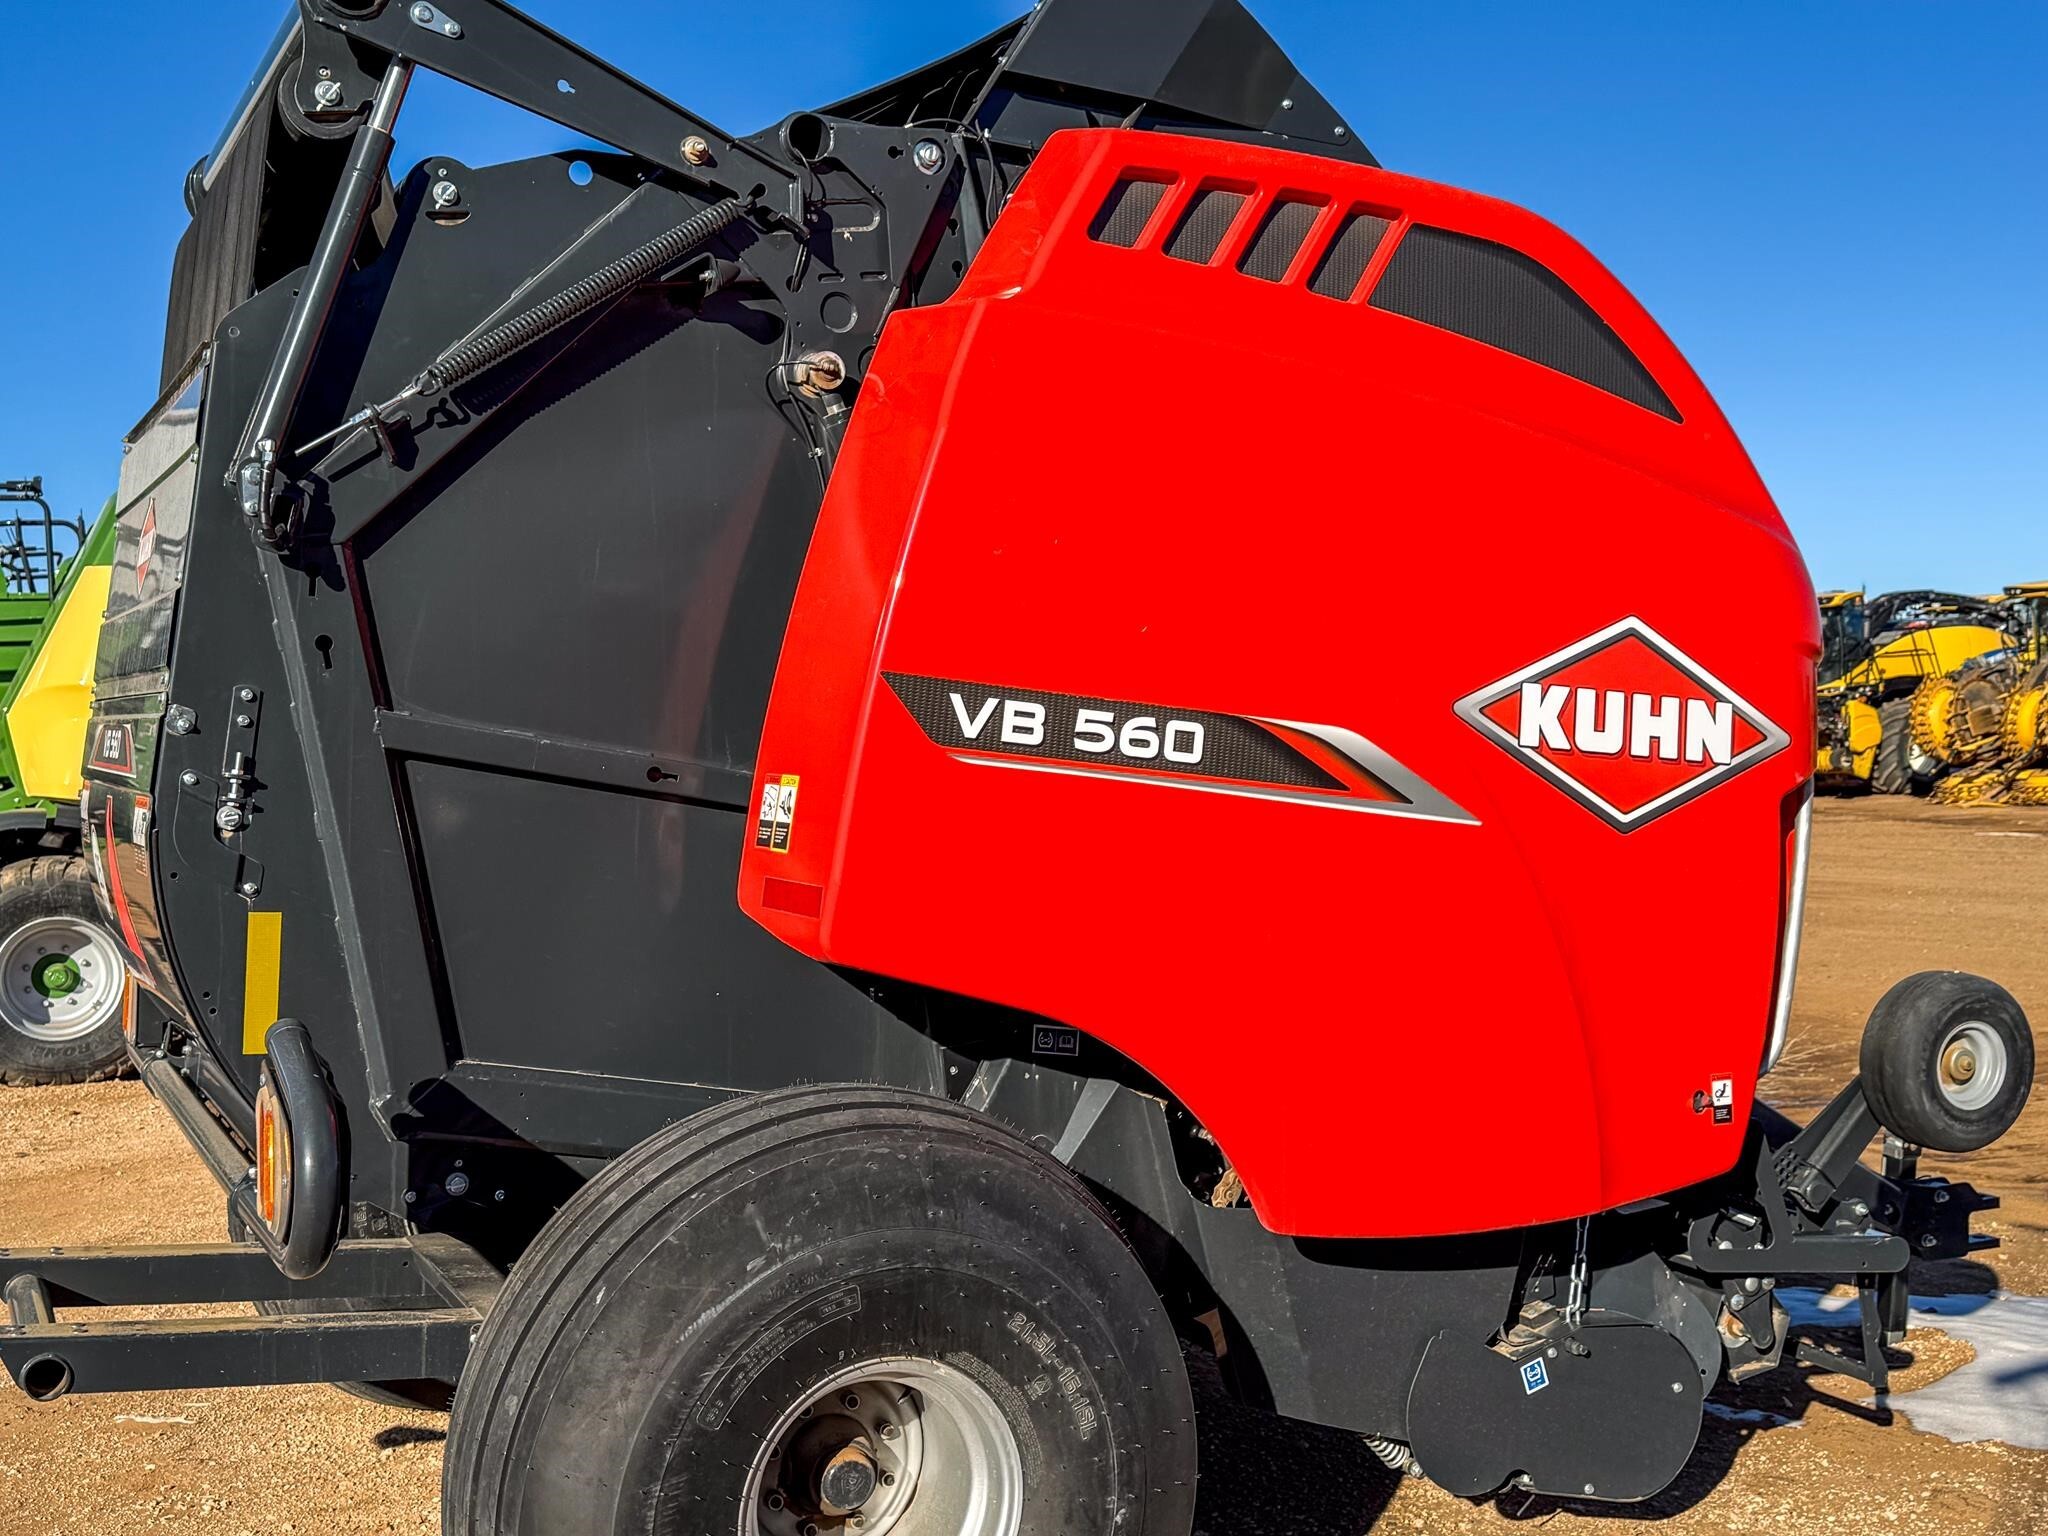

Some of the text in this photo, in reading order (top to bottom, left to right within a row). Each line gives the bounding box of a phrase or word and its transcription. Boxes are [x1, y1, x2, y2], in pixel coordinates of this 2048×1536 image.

[949, 692, 1205, 764] VB 560
[1519, 682, 1733, 765] KUHN
